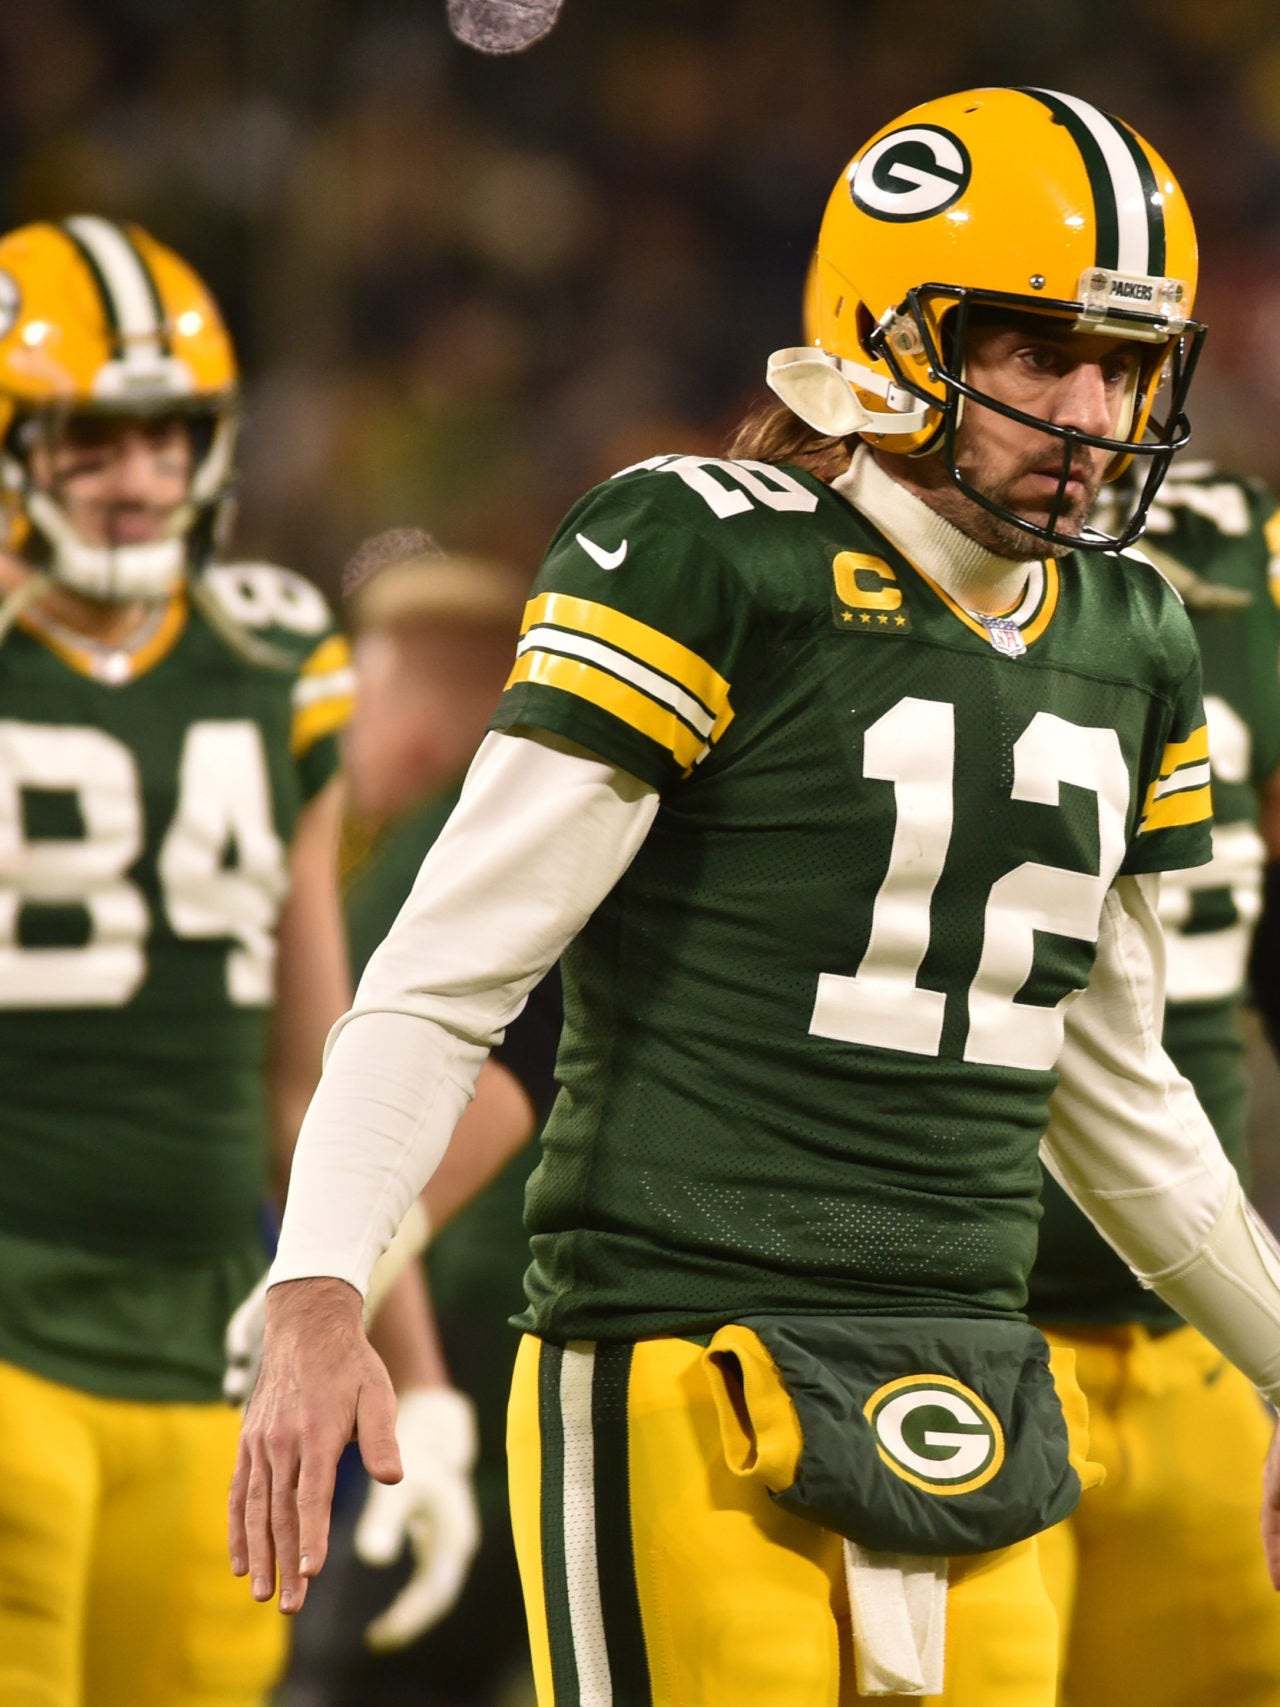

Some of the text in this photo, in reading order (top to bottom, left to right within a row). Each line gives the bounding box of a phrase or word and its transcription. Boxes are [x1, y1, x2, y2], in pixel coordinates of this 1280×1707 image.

[852, 127, 967, 216] G
[1109, 280, 1154, 301] PACKERS
[833, 550, 903, 611] C
[0, 716, 289, 1009] 84
[808, 696, 1130, 1071] 12
[875, 1389, 991, 1480] G
